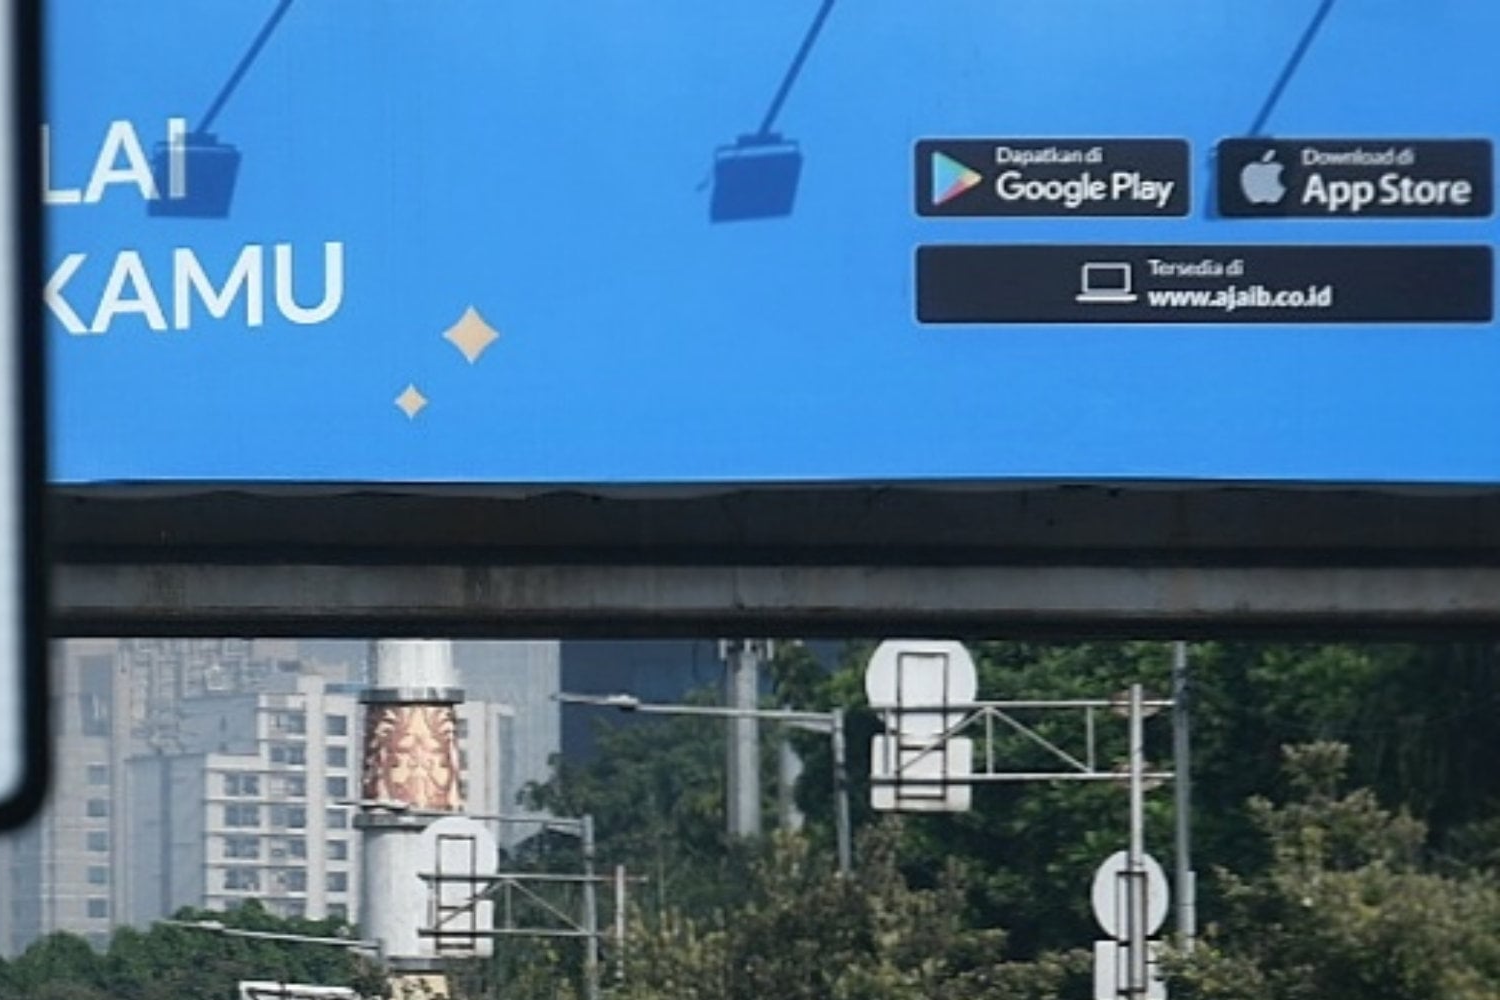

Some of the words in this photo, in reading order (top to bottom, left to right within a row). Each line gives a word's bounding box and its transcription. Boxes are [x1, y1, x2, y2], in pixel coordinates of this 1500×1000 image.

[995, 146, 1083, 166] Dapatkan
[1085, 146, 1104, 164] di
[1301, 147, 1394, 166] Download
[1396, 147, 1415, 166] di
[995, 170, 1108, 208] Google
[1110, 171, 1176, 209] Play
[1301, 173, 1376, 212] App
[1378, 172, 1473, 205] Store
[1146, 259, 1224, 277] Tersedia
[1225, 259, 1245, 277] di
[1147, 284, 1333, 312] www.ajaib.co.id
